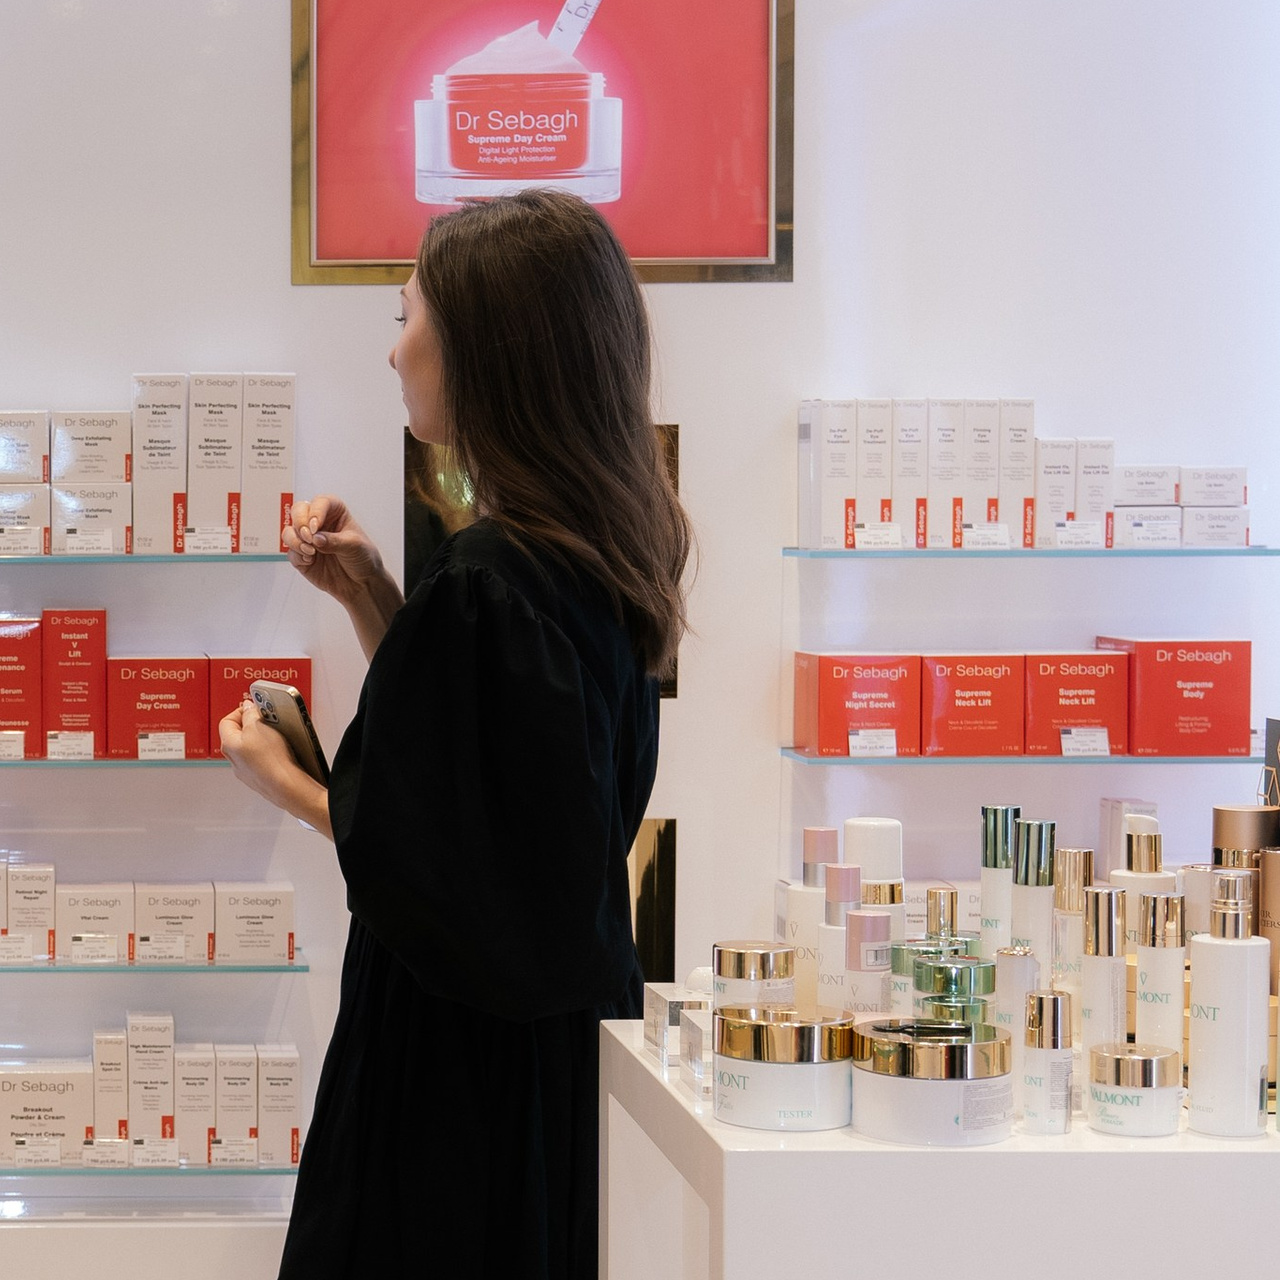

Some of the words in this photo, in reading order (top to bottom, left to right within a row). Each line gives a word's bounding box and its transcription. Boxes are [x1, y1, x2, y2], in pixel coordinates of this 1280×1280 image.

[574, 0, 592, 19] Dr
[456, 111, 480, 130] Dr
[488, 109, 578, 133] Sebagh
[468, 135, 511, 145] Supreme
[514, 134, 533, 144] Day
[535, 133, 567, 142] Cream
[479, 147, 500, 155] Digital
[478, 156, 518, 164] Anti-Ageing
[206, 379, 238, 388] Sebagh
[260, 379, 291, 388] Sebagh
[64, 419, 77, 427] Dr
[79, 418, 118, 428] Sebagh
[177, 503, 185, 536] Sebagh
[177, 537, 183, 547] Dr
[847, 536, 853, 545] Dr
[1026, 535, 1032, 544] Dr
[51, 617, 62, 625] Dr
[64, 617, 99, 626] Sebagh
[1156, 650, 1172, 661] Dr
[1177, 649, 1232, 664] Sebagh
[121, 668, 137, 679] Dr
[141, 668, 195, 681] Sebagh
[224, 668, 240, 679] Dr
[244, 667, 298, 681] Sebagh
[833, 667, 848, 678] Dr
[853, 666, 908, 681] Sebagh
[936, 665, 951, 677] Dr
[956, 664, 1011, 679] Sebagh
[1039, 664, 1055, 675] Dr
[1060, 663, 1114, 678] Sebagh
[1176, 680, 1213, 690] Supreme
[140, 693, 176, 701] Supreme
[852, 691, 888, 700] Supreme
[955, 689, 992, 698] Supreme
[1059, 688, 1096, 697] Supreme
[1183, 690, 1205, 700] Body
[845, 701, 867, 709] Night
[869, 701, 895, 709] Secret
[955, 699, 976, 707] Neck
[978, 699, 992, 707] Lift
[1059, 697, 1080, 705] Neck
[1082, 697, 1096, 705] Lift
[136, 702, 152, 711] Day
[153, 702, 180, 710] Cream
[69, 898, 81, 906] Dr
[83, 897, 121, 908] Sebagh
[148, 898, 161, 906] Dr
[163, 897, 201, 907] Sebagh
[229, 897, 241, 906] Dr
[243, 897, 281, 907] Sebagh
[1138, 992, 1171, 1004] MONT
[142, 1025, 170, 1033] Sebagh
[2, 1081, 18, 1091] Dr
[21, 1081, 74, 1094] Sebagh
[1090, 1086, 1143, 1107] VALMONT
[777, 1110, 813, 1119] TESTER
